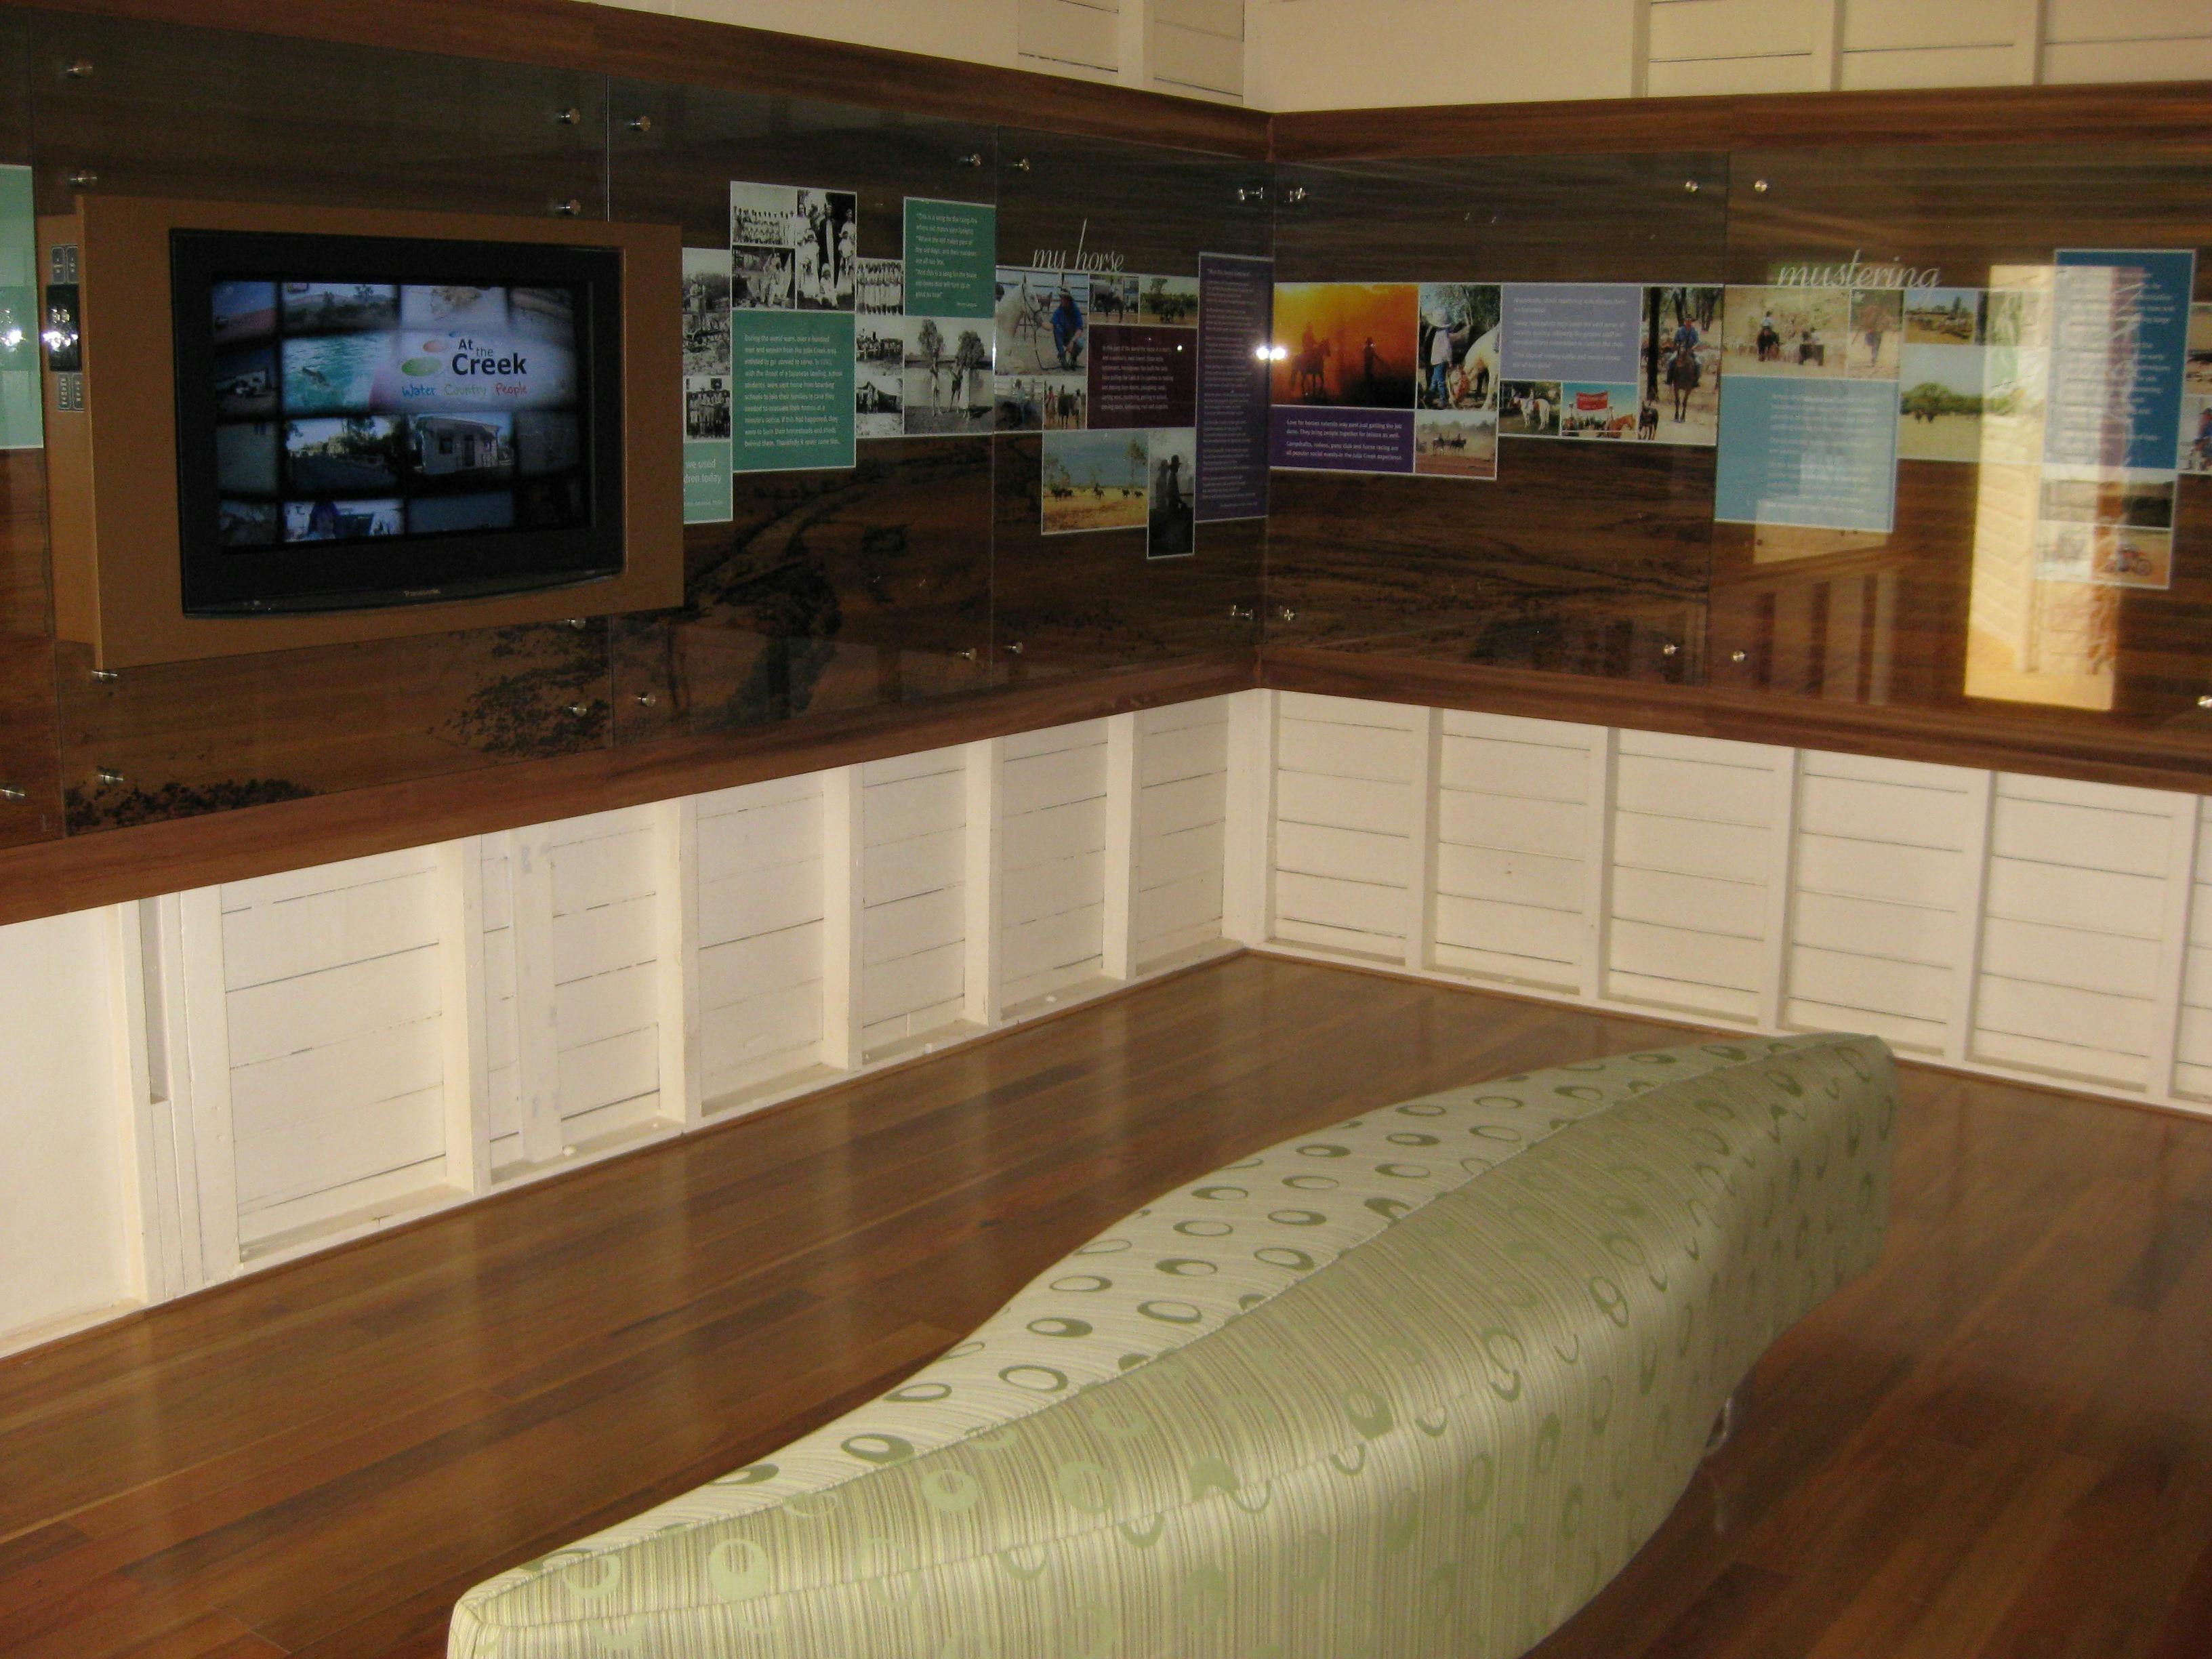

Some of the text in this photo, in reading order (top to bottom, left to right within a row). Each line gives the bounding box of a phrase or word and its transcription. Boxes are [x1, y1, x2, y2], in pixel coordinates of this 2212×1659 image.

[1032, 217, 1124, 271] my horse
[1777, 249, 1940, 301] mustering
[458, 339, 473, 350] At
[476, 346, 493, 356] the
[452, 352, 527, 375] Creek
[402, 382, 527, 398] Water Country People
